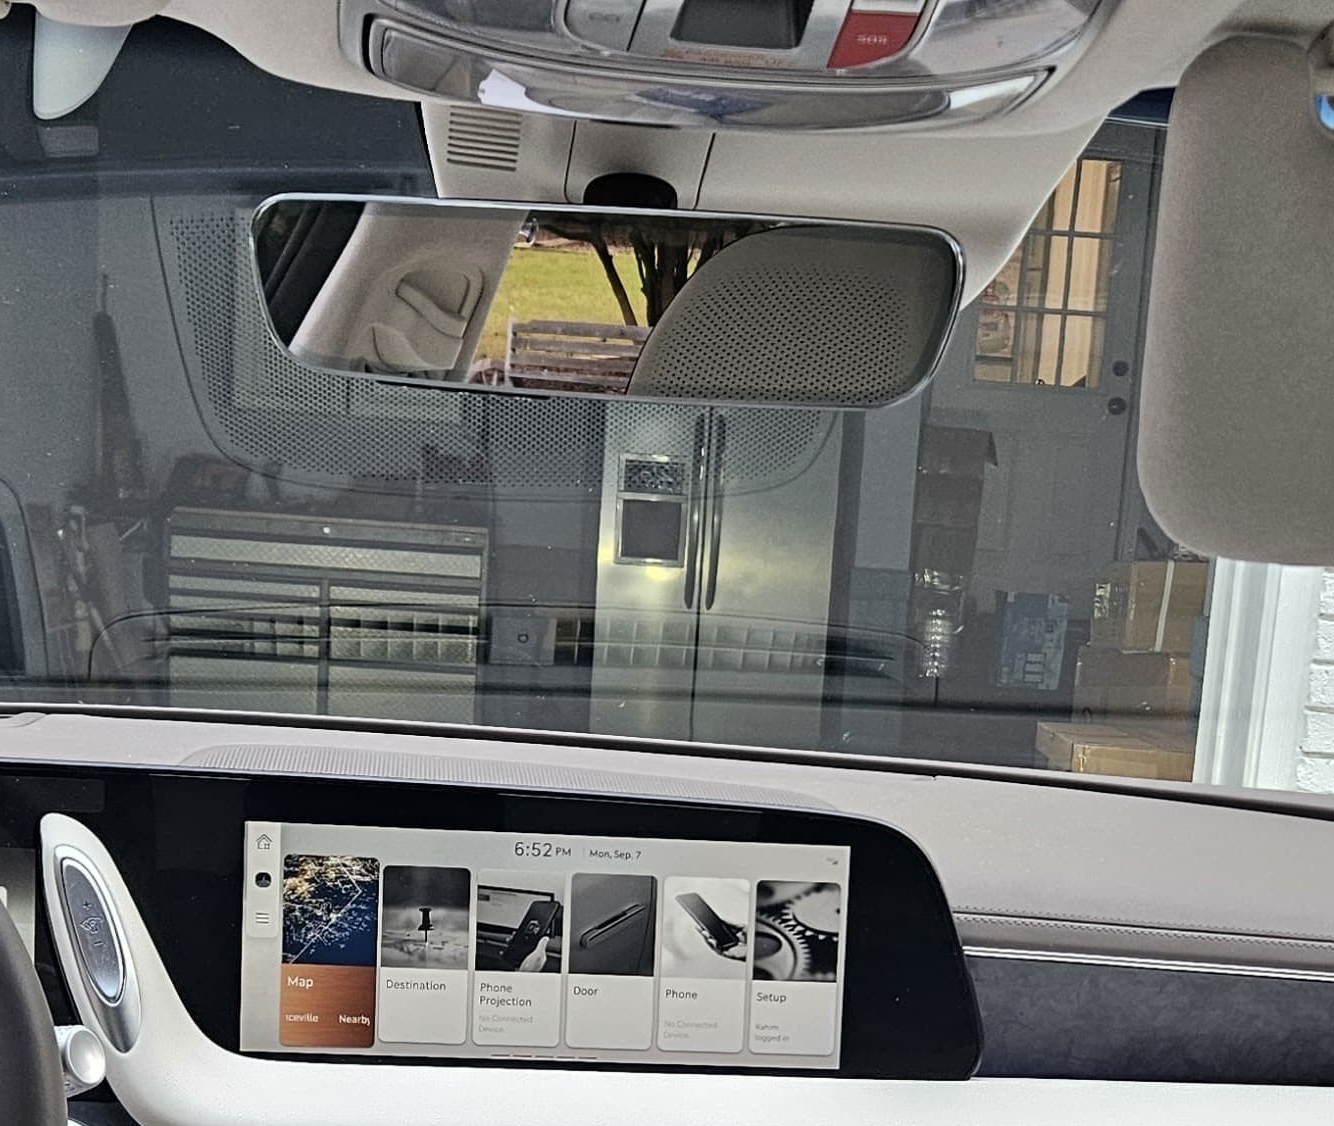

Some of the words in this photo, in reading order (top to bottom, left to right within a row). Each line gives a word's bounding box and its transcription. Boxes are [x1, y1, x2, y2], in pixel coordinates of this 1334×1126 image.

[515, 841, 553, 857] 6:52
[555, 847, 571, 857] PM
[614, 850, 634, 860] Sep.
[635, 851, 641, 860] 7
[287, 976, 313, 989] Map
[386, 979, 447, 991] Destination
[480, 983, 512, 993] Phone
[573, 986, 598, 996] Door
[665, 989, 698, 1000] Phone
[479, 996, 532, 1007] Projection
[756, 992, 787, 1004] Setup
